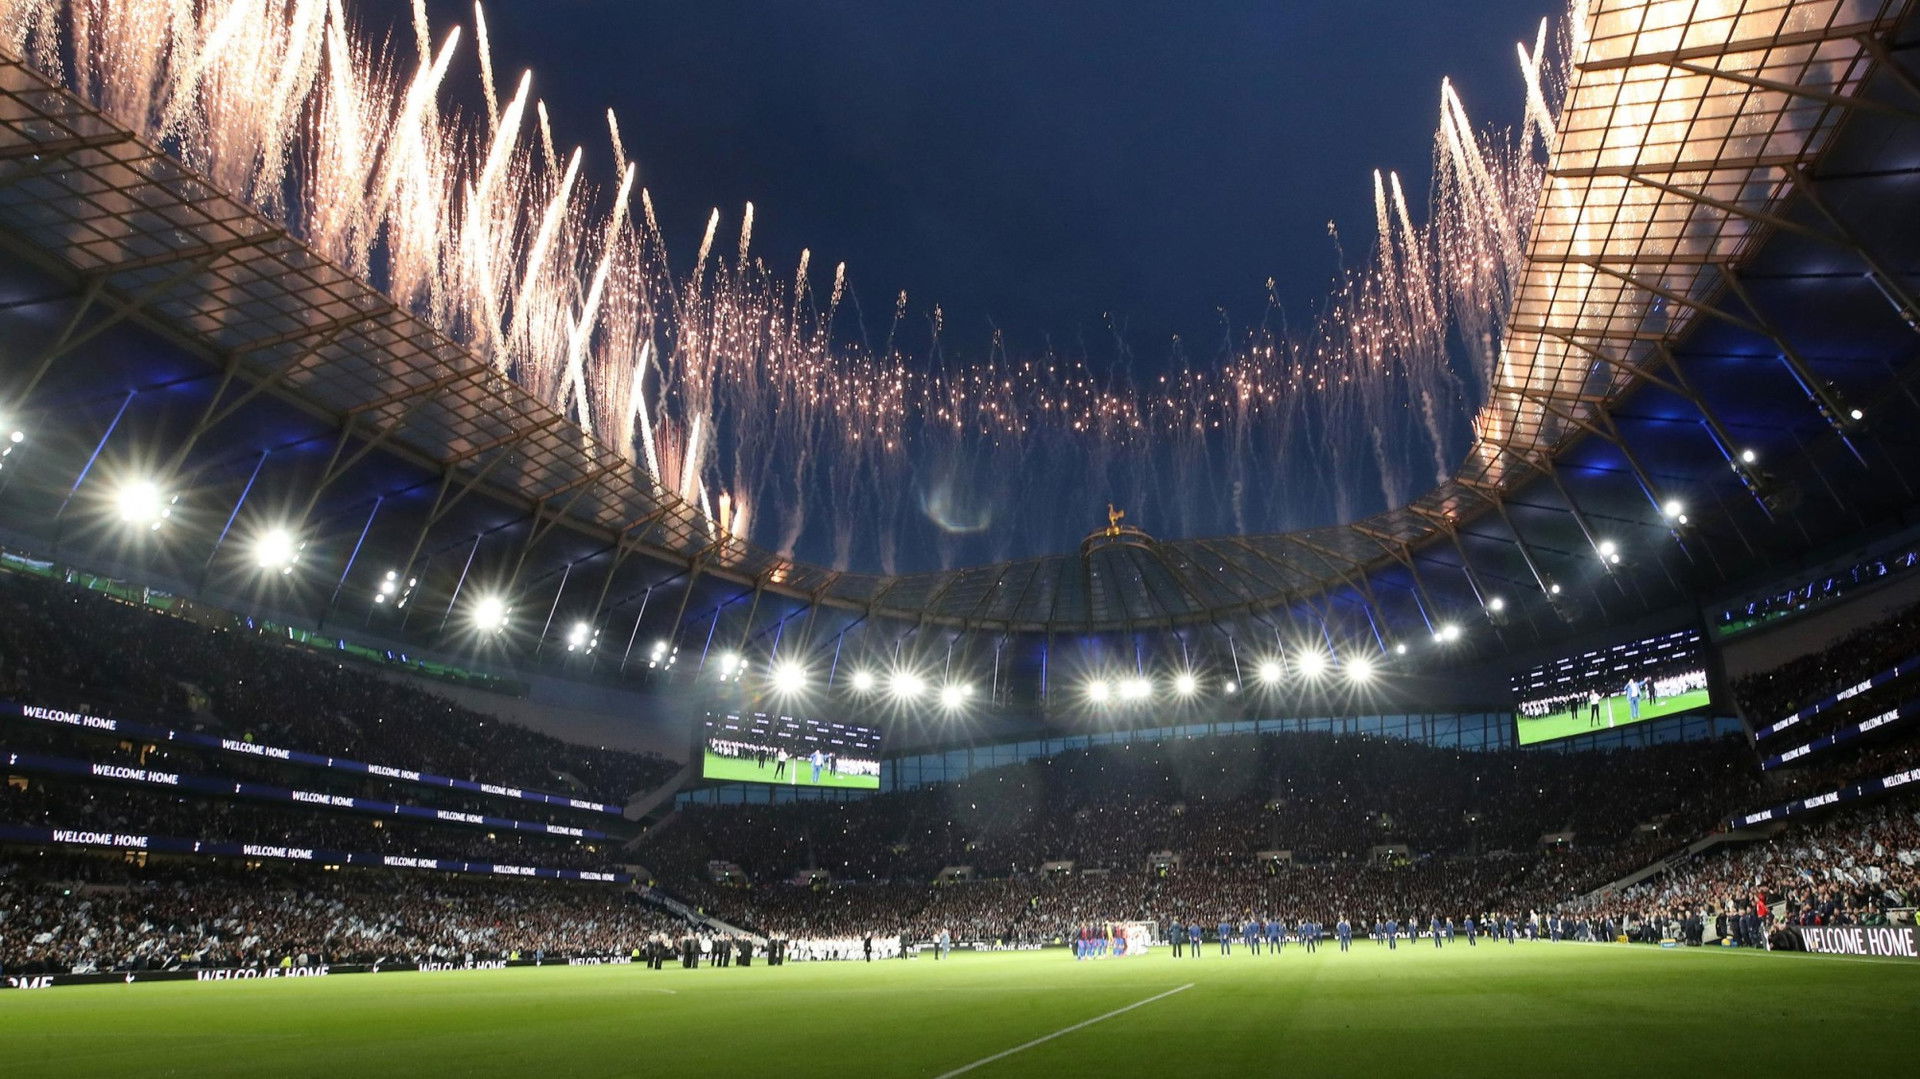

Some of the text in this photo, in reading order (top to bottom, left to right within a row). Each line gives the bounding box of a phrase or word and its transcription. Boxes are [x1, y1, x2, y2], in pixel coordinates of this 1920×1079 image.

[24, 705, 117, 730] WELCOME HOME
[223, 739, 290, 759] WELCOME HOME
[93, 764, 179, 785] WELCOME HOME
[368, 764, 420, 781] WELCOME HOME
[1882, 771, 1911, 788] WELCOME
[292, 791, 354, 807] WELCOME HOME
[481, 784, 522, 798] WELCOME HOME
[437, 810, 484, 824] WELCOME HOME
[53, 830, 148, 848] WELCOME HOME
[243, 845, 313, 860] WELCOME HOME
[384, 856, 437, 869] WELCOME HOME
[1801, 928, 1918, 957] WELCOME HOME
[476, 960, 507, 970] HOME
[568, 956, 608, 966] WELCO
[285, 966, 330, 977] HOME
